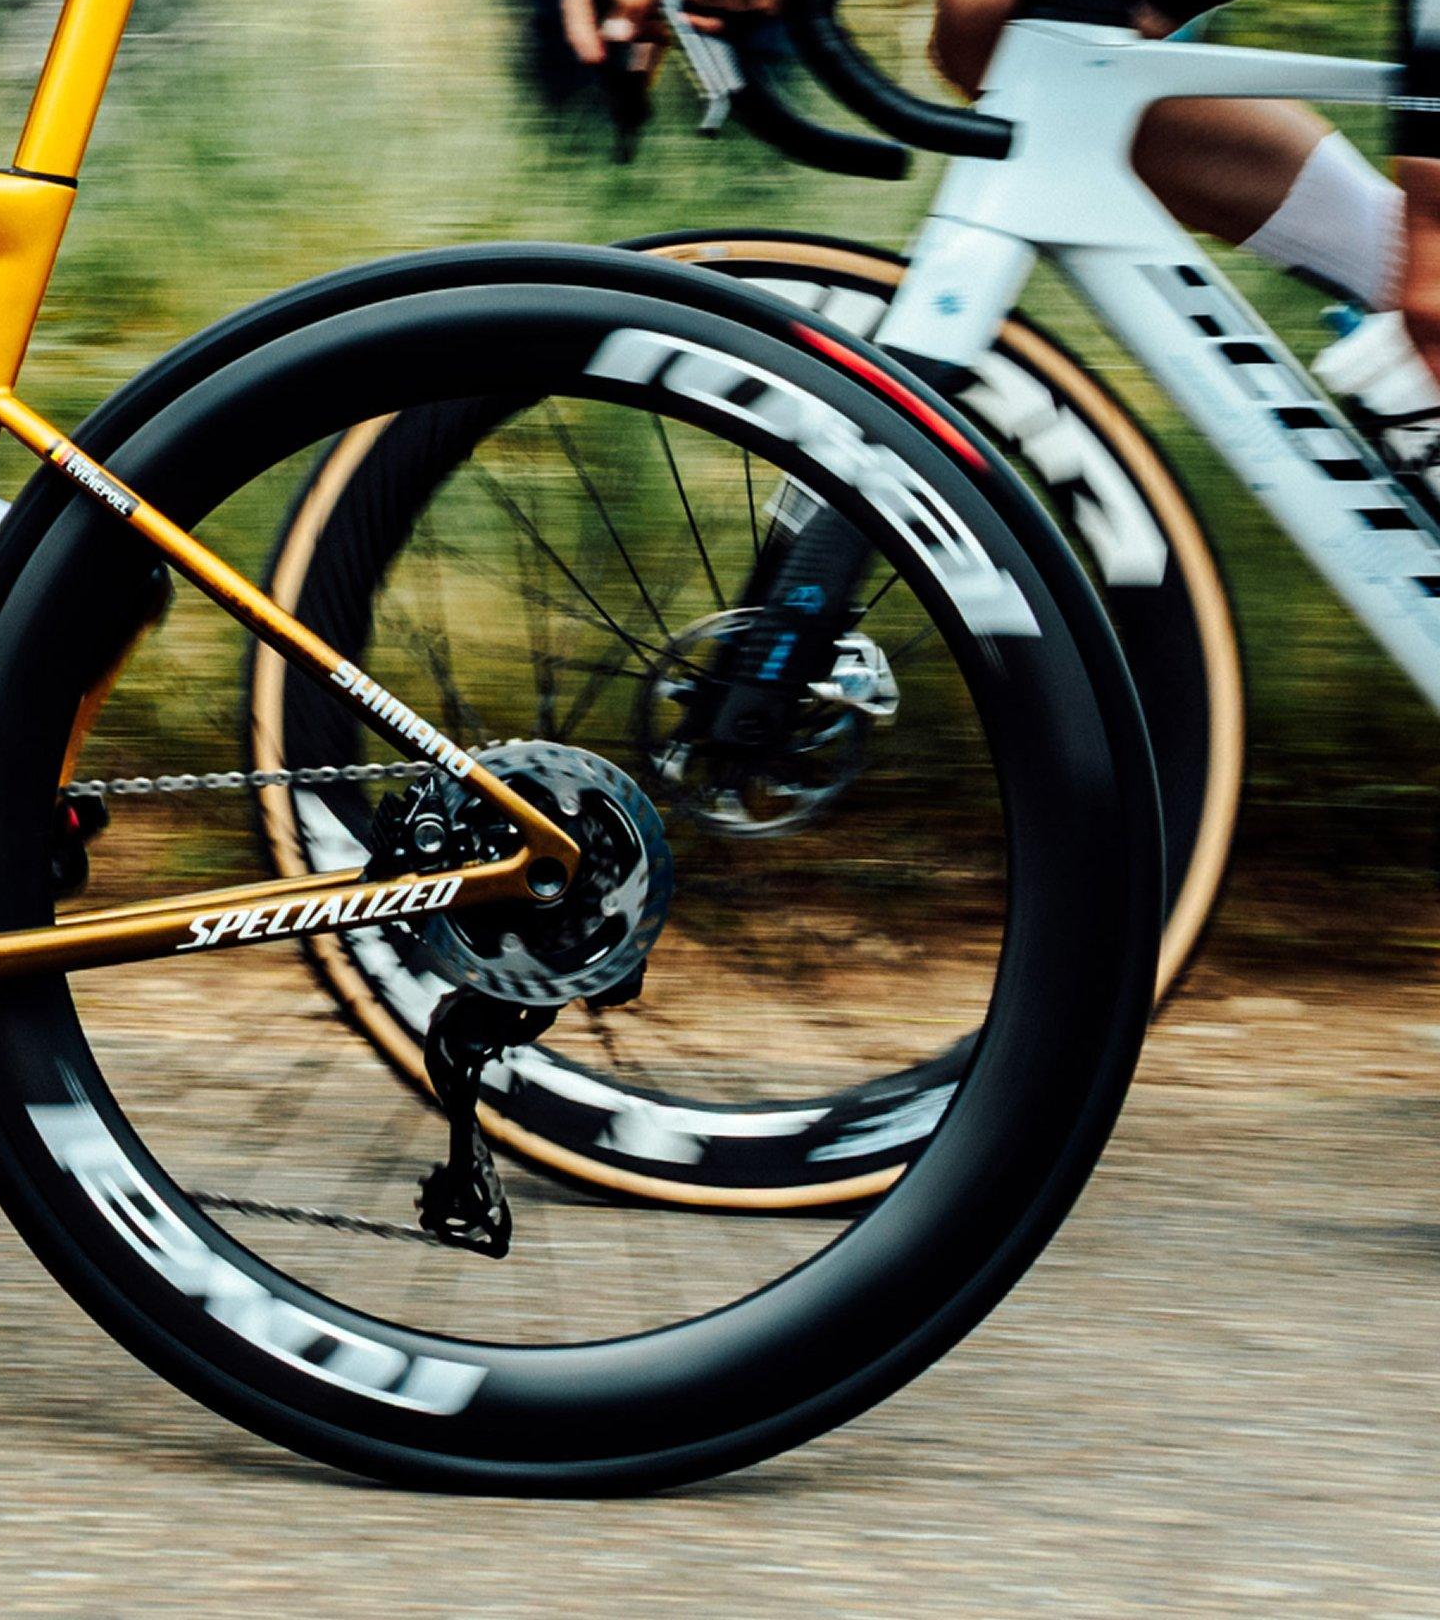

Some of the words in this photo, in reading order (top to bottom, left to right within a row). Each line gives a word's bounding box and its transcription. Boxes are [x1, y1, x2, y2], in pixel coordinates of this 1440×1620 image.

[65, 458, 130, 516] EVENEPOEL
[331, 659, 477, 780] SHIMANO
[176, 876, 464, 951] SPECIALIZED
